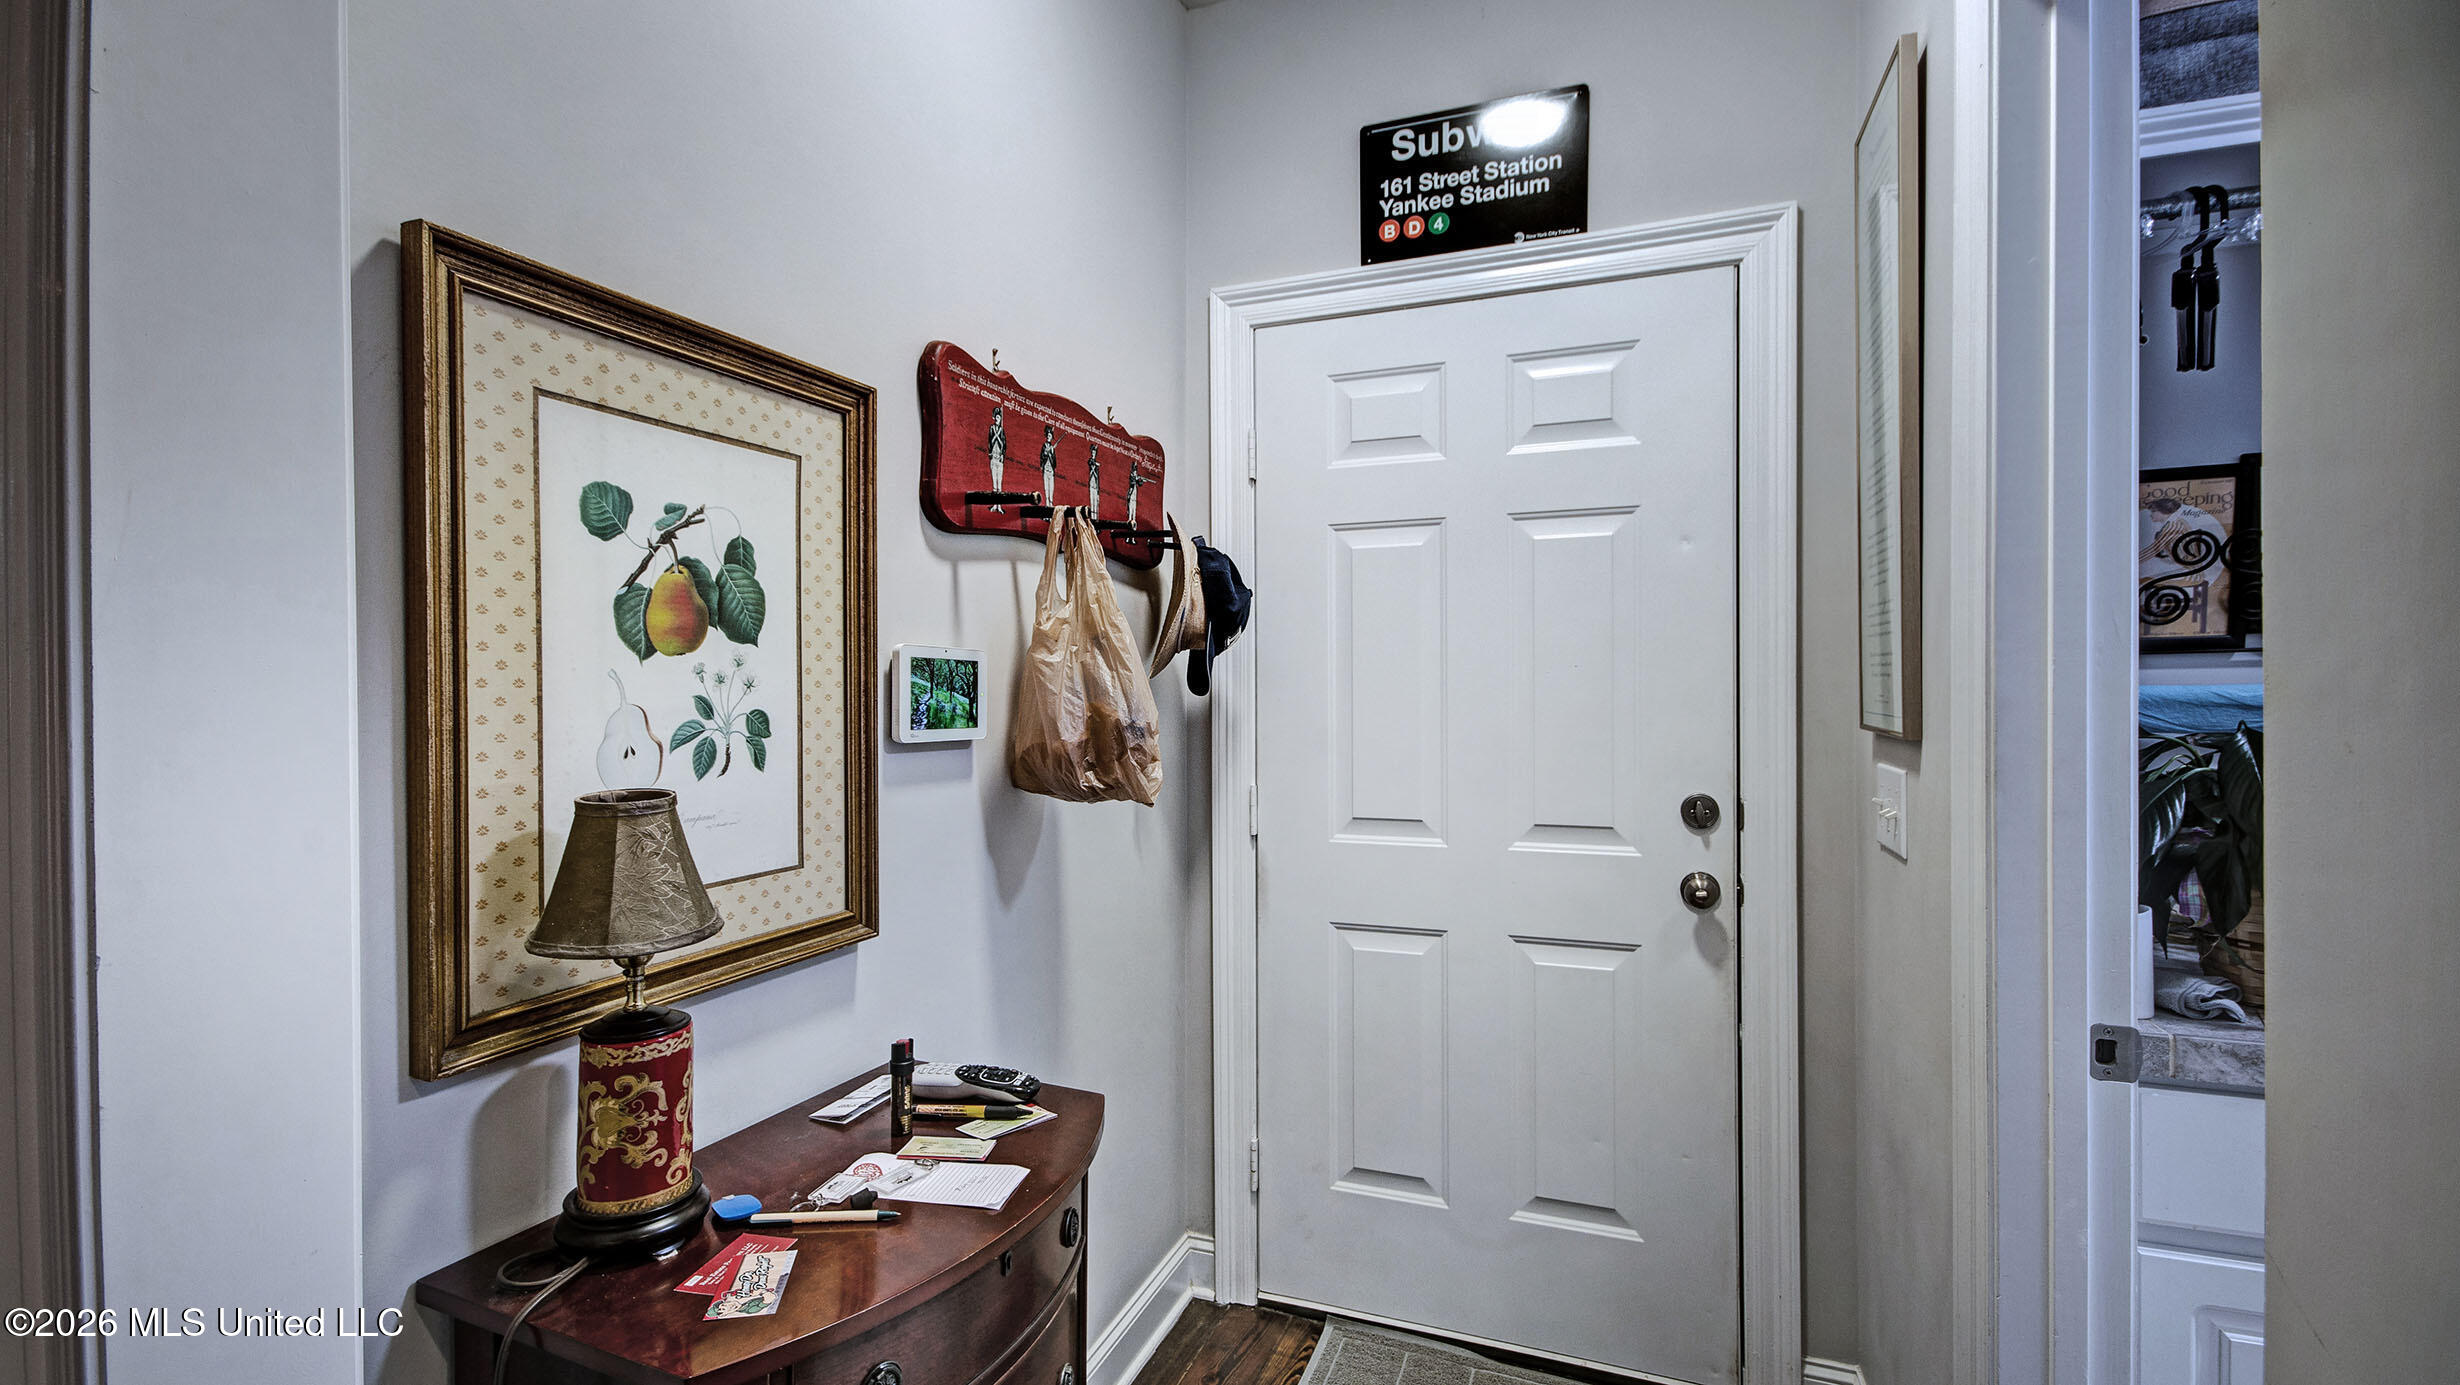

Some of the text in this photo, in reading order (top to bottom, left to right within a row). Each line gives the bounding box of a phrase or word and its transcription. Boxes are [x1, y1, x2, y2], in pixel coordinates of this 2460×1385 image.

[1391, 121, 1490, 162] Subw
[1380, 154, 1563, 198] 161 Street Station
[1379, 176, 1550, 218] Yankee Stadium
[1384, 217, 1444, 239] B D 4
[1558, 228, 1575, 236] Transit
